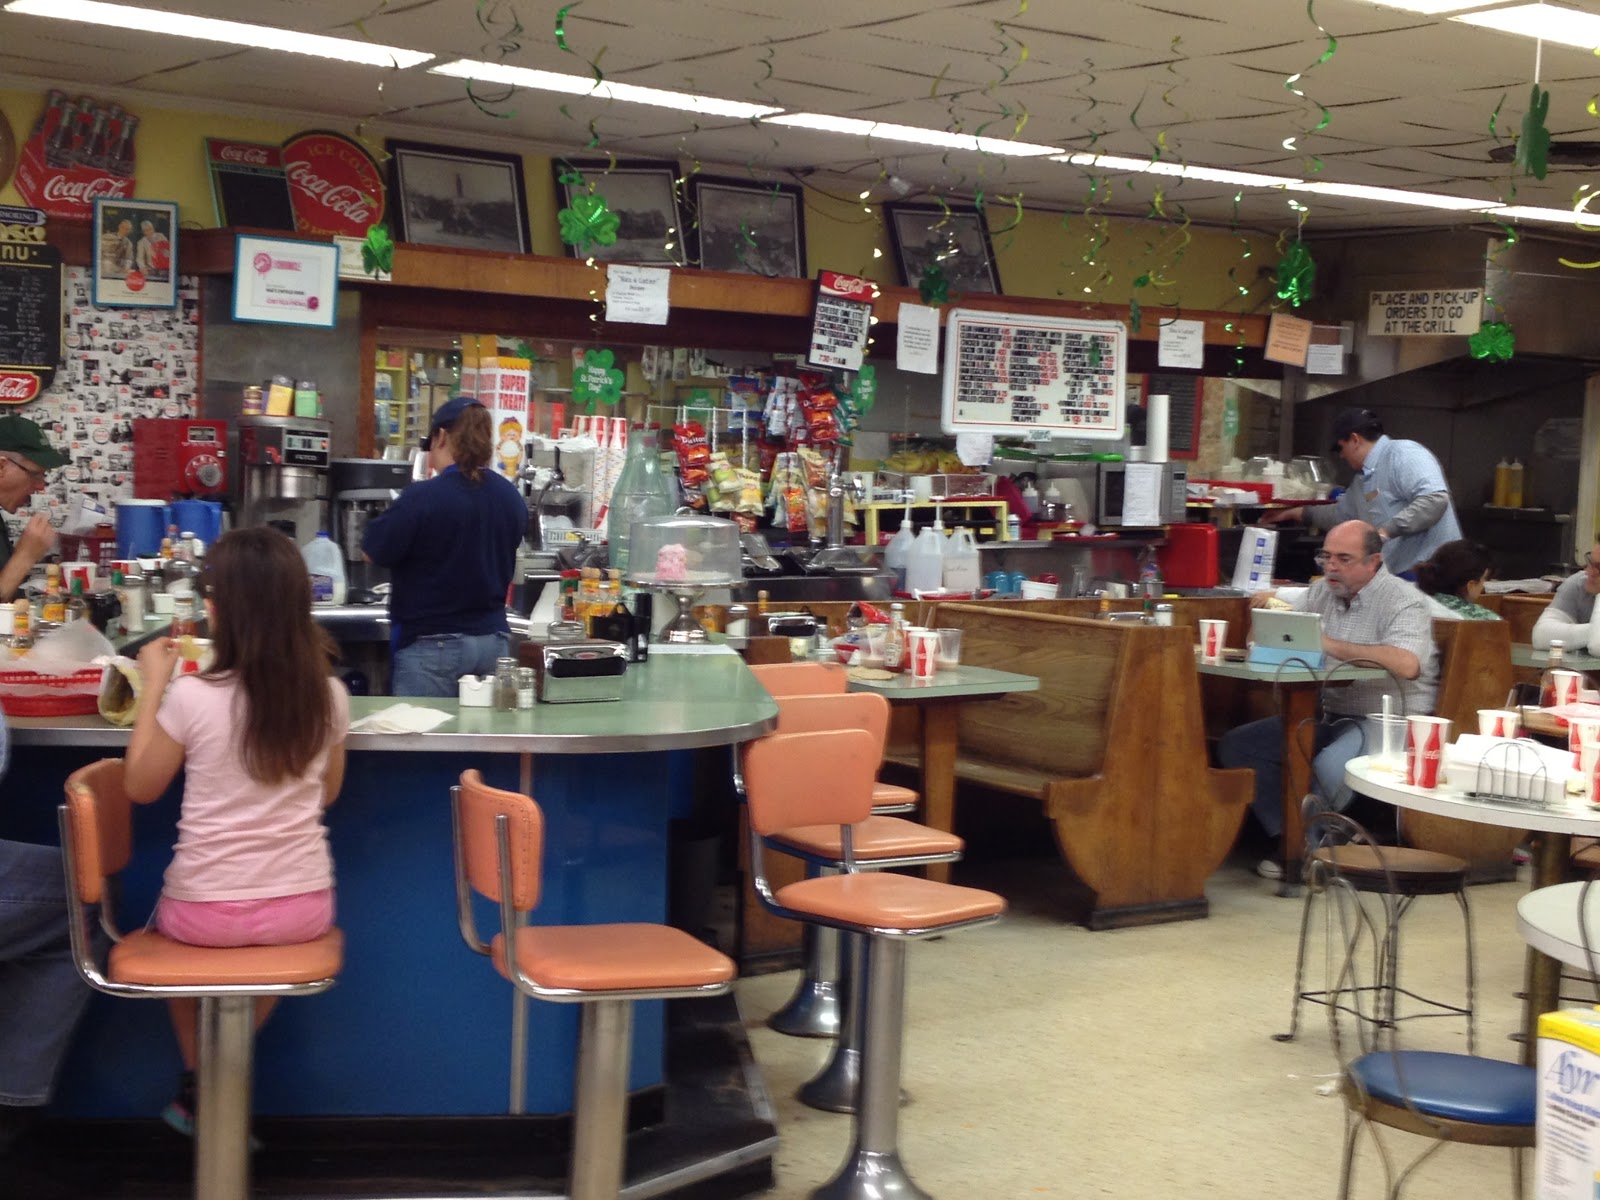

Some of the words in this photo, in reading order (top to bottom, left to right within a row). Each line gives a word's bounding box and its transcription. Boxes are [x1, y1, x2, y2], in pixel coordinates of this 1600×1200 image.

[1372, 293, 1406, 305] PLACE
[1408, 292, 1429, 305] AND
[1433, 291, 1479, 304] PICK-UP
[1385, 306, 1427, 319] ORDERS
[1431, 306, 1445, 318] TO
[1448, 306, 1463, 318] GO
[1384, 321, 1398, 333] AT
[1401, 321, 1421, 333] THE
[1423, 320, 1456, 333] GRILL
